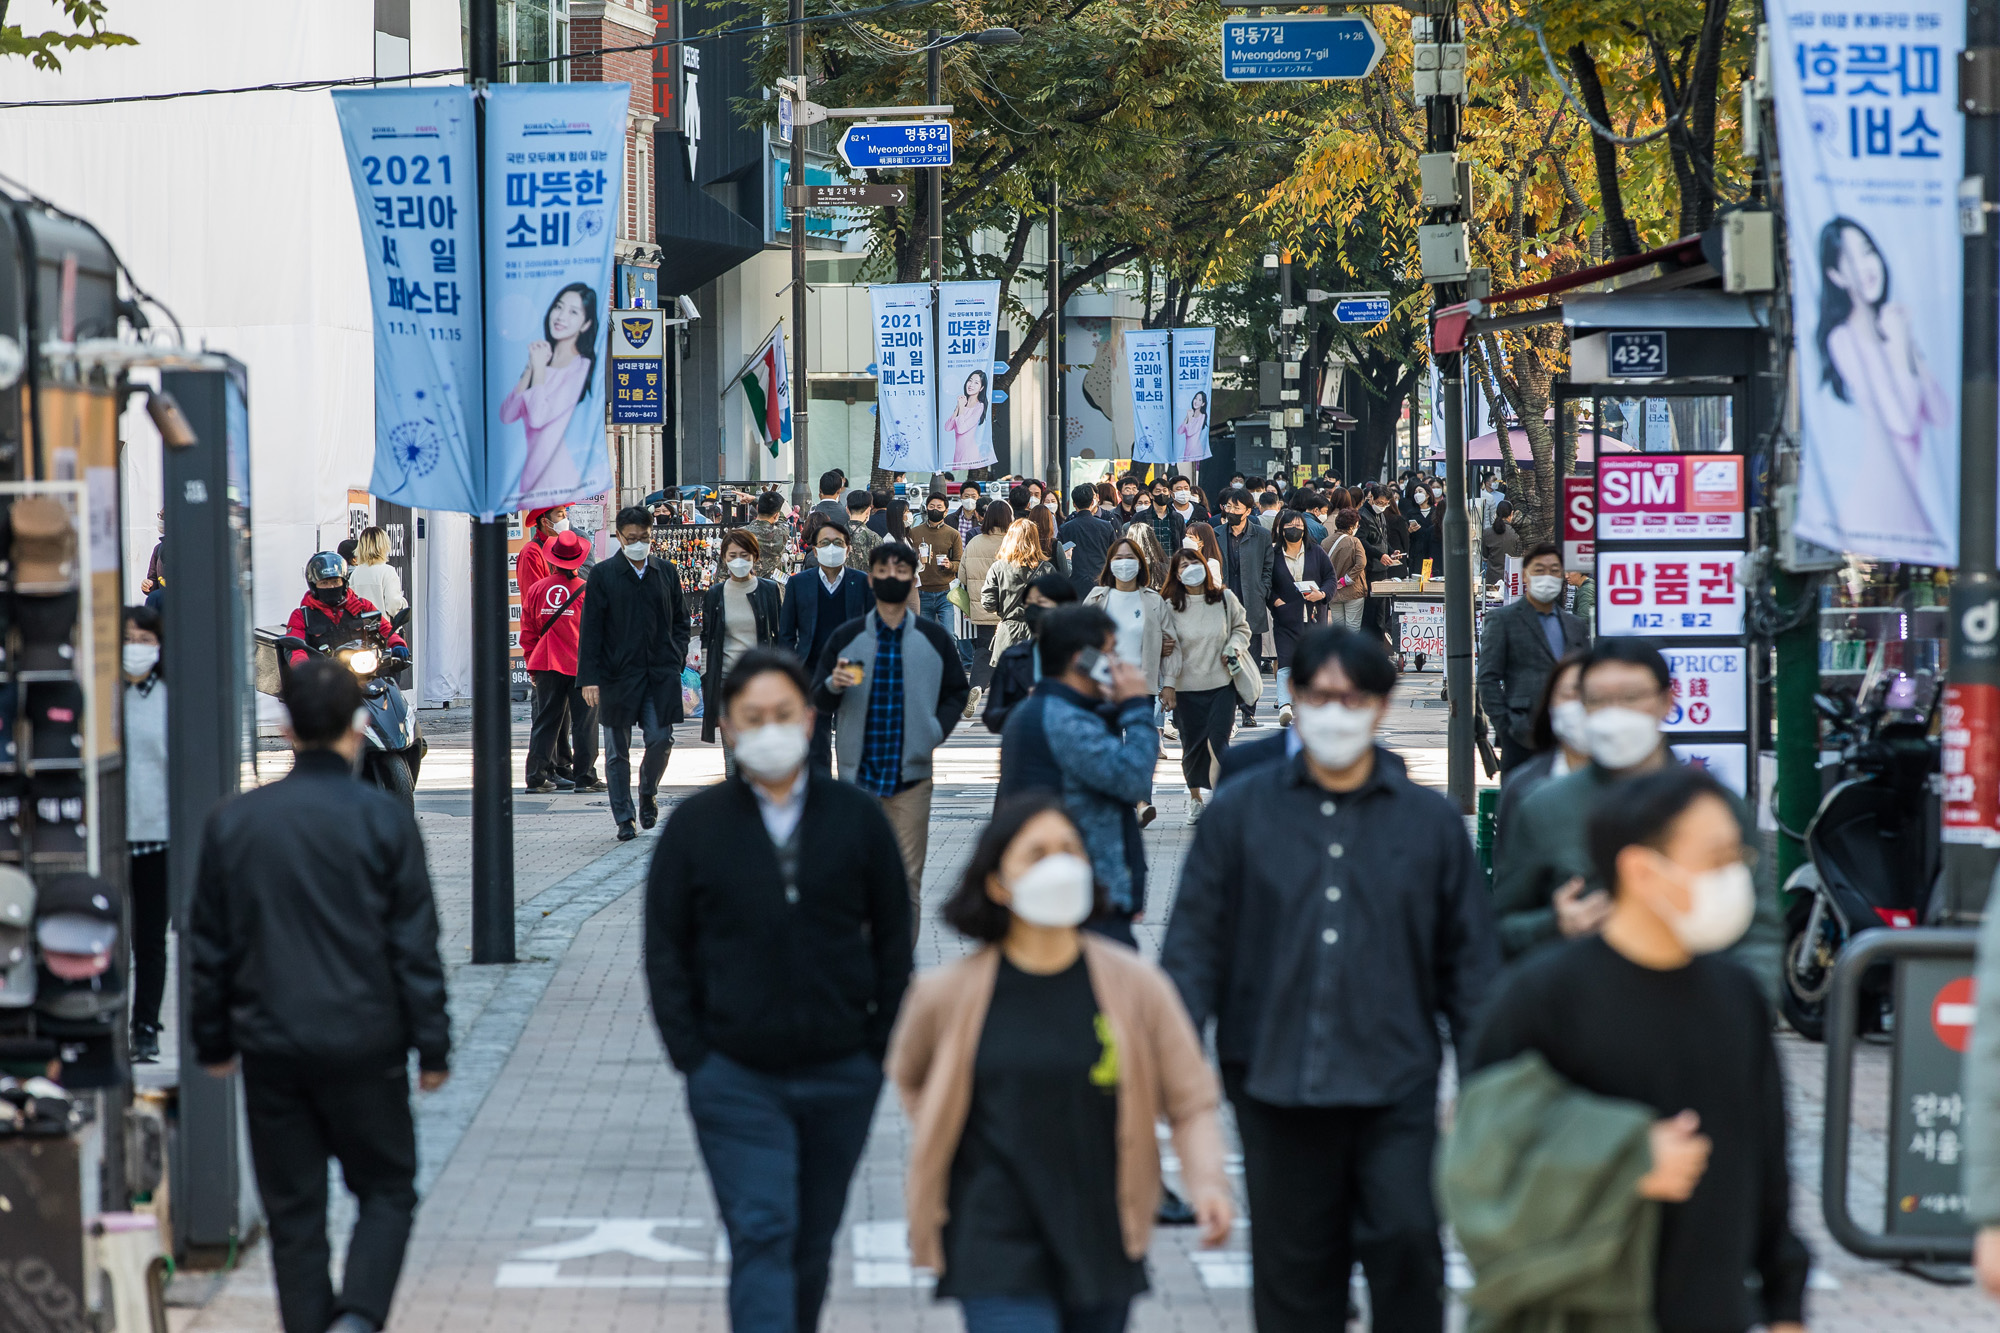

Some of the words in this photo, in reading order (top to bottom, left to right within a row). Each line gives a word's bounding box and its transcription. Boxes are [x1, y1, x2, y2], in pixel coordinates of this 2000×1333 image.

[1231, 26, 1284, 45] 명동7길
[1353, 32, 1364, 40] 26
[1232, 50, 1301, 62] Myeongdong
[1305, 48, 1329, 60] 7-gil
[905, 127, 948, 141] 명동8길
[868, 145, 926, 155] Myeongdong
[927, 143, 948, 154] 8-gil
[506, 153, 525, 164] 국민
[527, 152, 566, 164] 모두에게
[569, 151, 588, 162] 힘이
[362, 155, 452, 185] 2021
[506, 169, 607, 207] 따뜻한
[374, 195, 458, 230] 코리아
[506, 211, 570, 248] 소비
[387, 276, 461, 316] 페스타
[881, 314, 921, 329] 2021
[948, 320, 991, 337] 따뜻한
[388, 322, 417, 335] 11.1
[429, 328, 461, 341] 11.15
[881, 331, 923, 348] 코리아
[948, 338, 975, 355] 소비
[882, 351, 896, 367] 세
[910, 351, 923, 367] 일
[1134, 351, 1161, 362] 2021
[1179, 355, 1210, 368] 따뜻한
[1614, 345, 1661, 365] 43-2
[883, 370, 925, 386] 페스타
[1134, 364, 1163, 376] 코리아
[1179, 369, 1199, 380] 소비
[1135, 378, 1144, 389] 세
[1154, 377, 1162, 389] 일
[618, 388, 658, 400] 파출소
[1136, 391, 1163, 403] 페스타
[1602, 470, 1676, 505] SIM
[1608, 562, 1736, 605] 상품권
[1632, 613, 1663, 628] 사고
[1681, 613, 1713, 628] 팔고
[1669, 655, 1738, 673] PRICE
